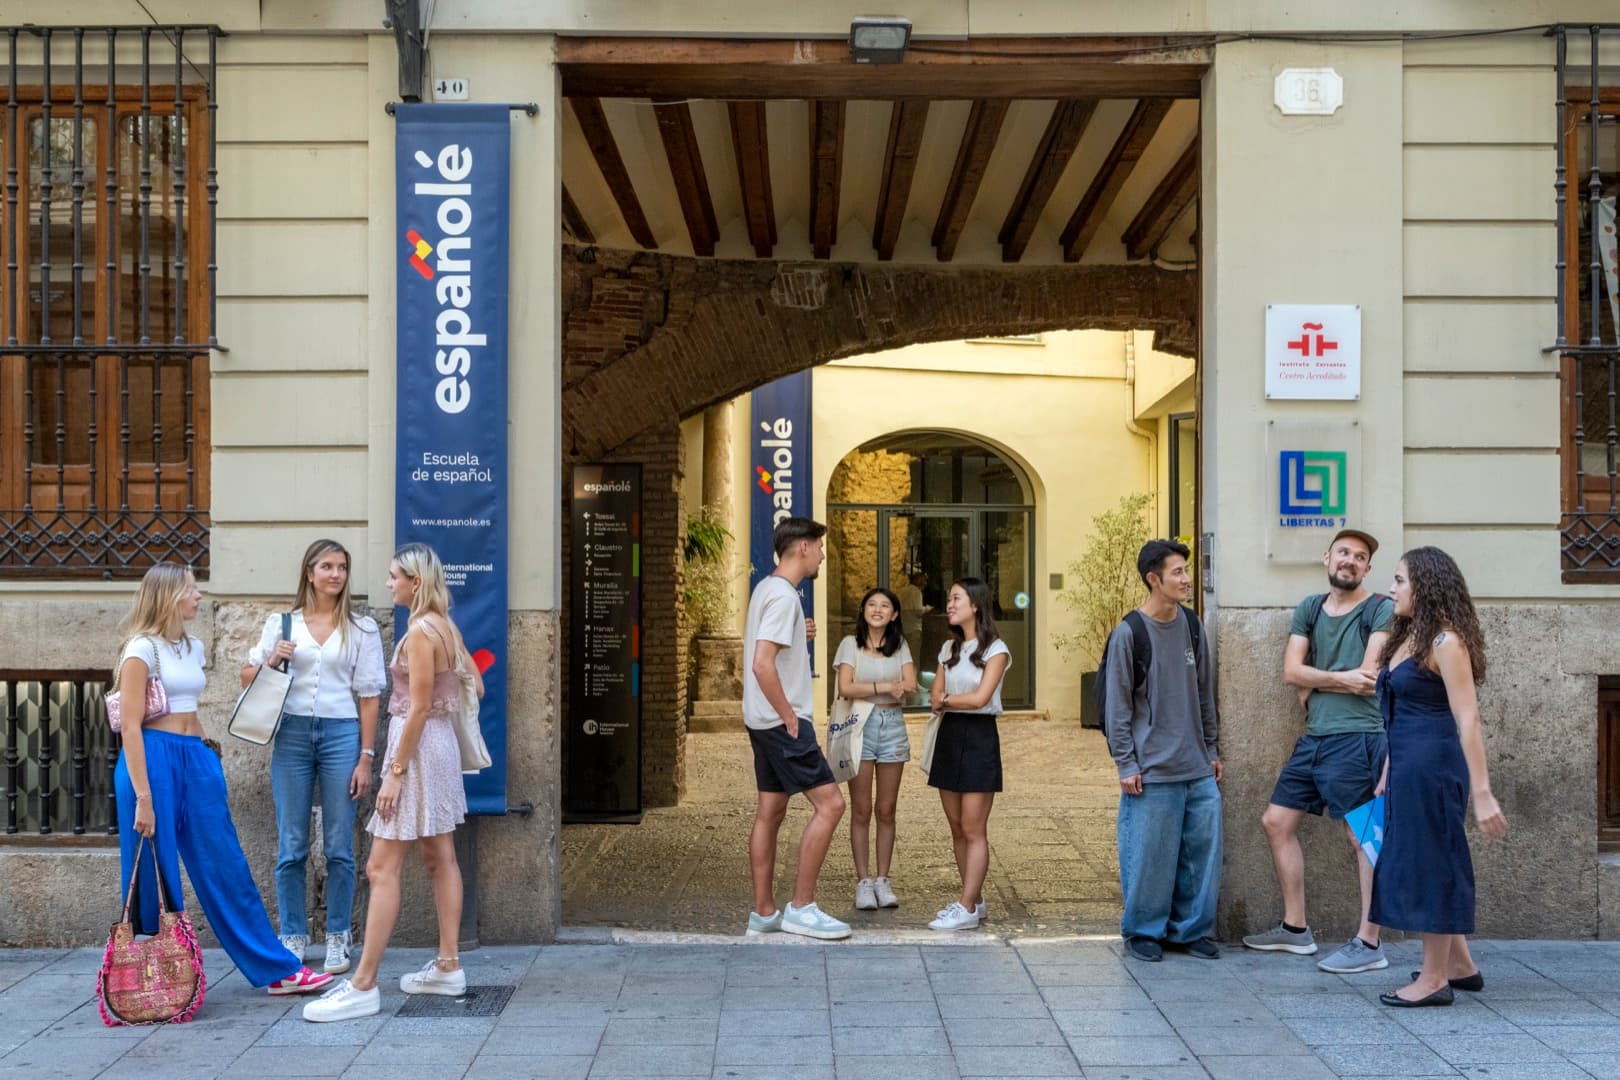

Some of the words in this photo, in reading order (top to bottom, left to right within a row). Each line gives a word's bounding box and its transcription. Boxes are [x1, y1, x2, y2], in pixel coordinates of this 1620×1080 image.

[436, 80, 463, 94] 40
[406, 144, 487, 414] españolé
[422, 451, 479, 466] Escuela
[412, 467, 430, 482] de
[433, 467, 492, 485] español
[411, 518, 492, 528] www.espanole.es
[1280, 518, 1335, 527] LIBERTAS
[1340, 518, 1347, 527] 7
[594, 543, 623, 551] Claustro
[443, 563, 493, 572] nternational
